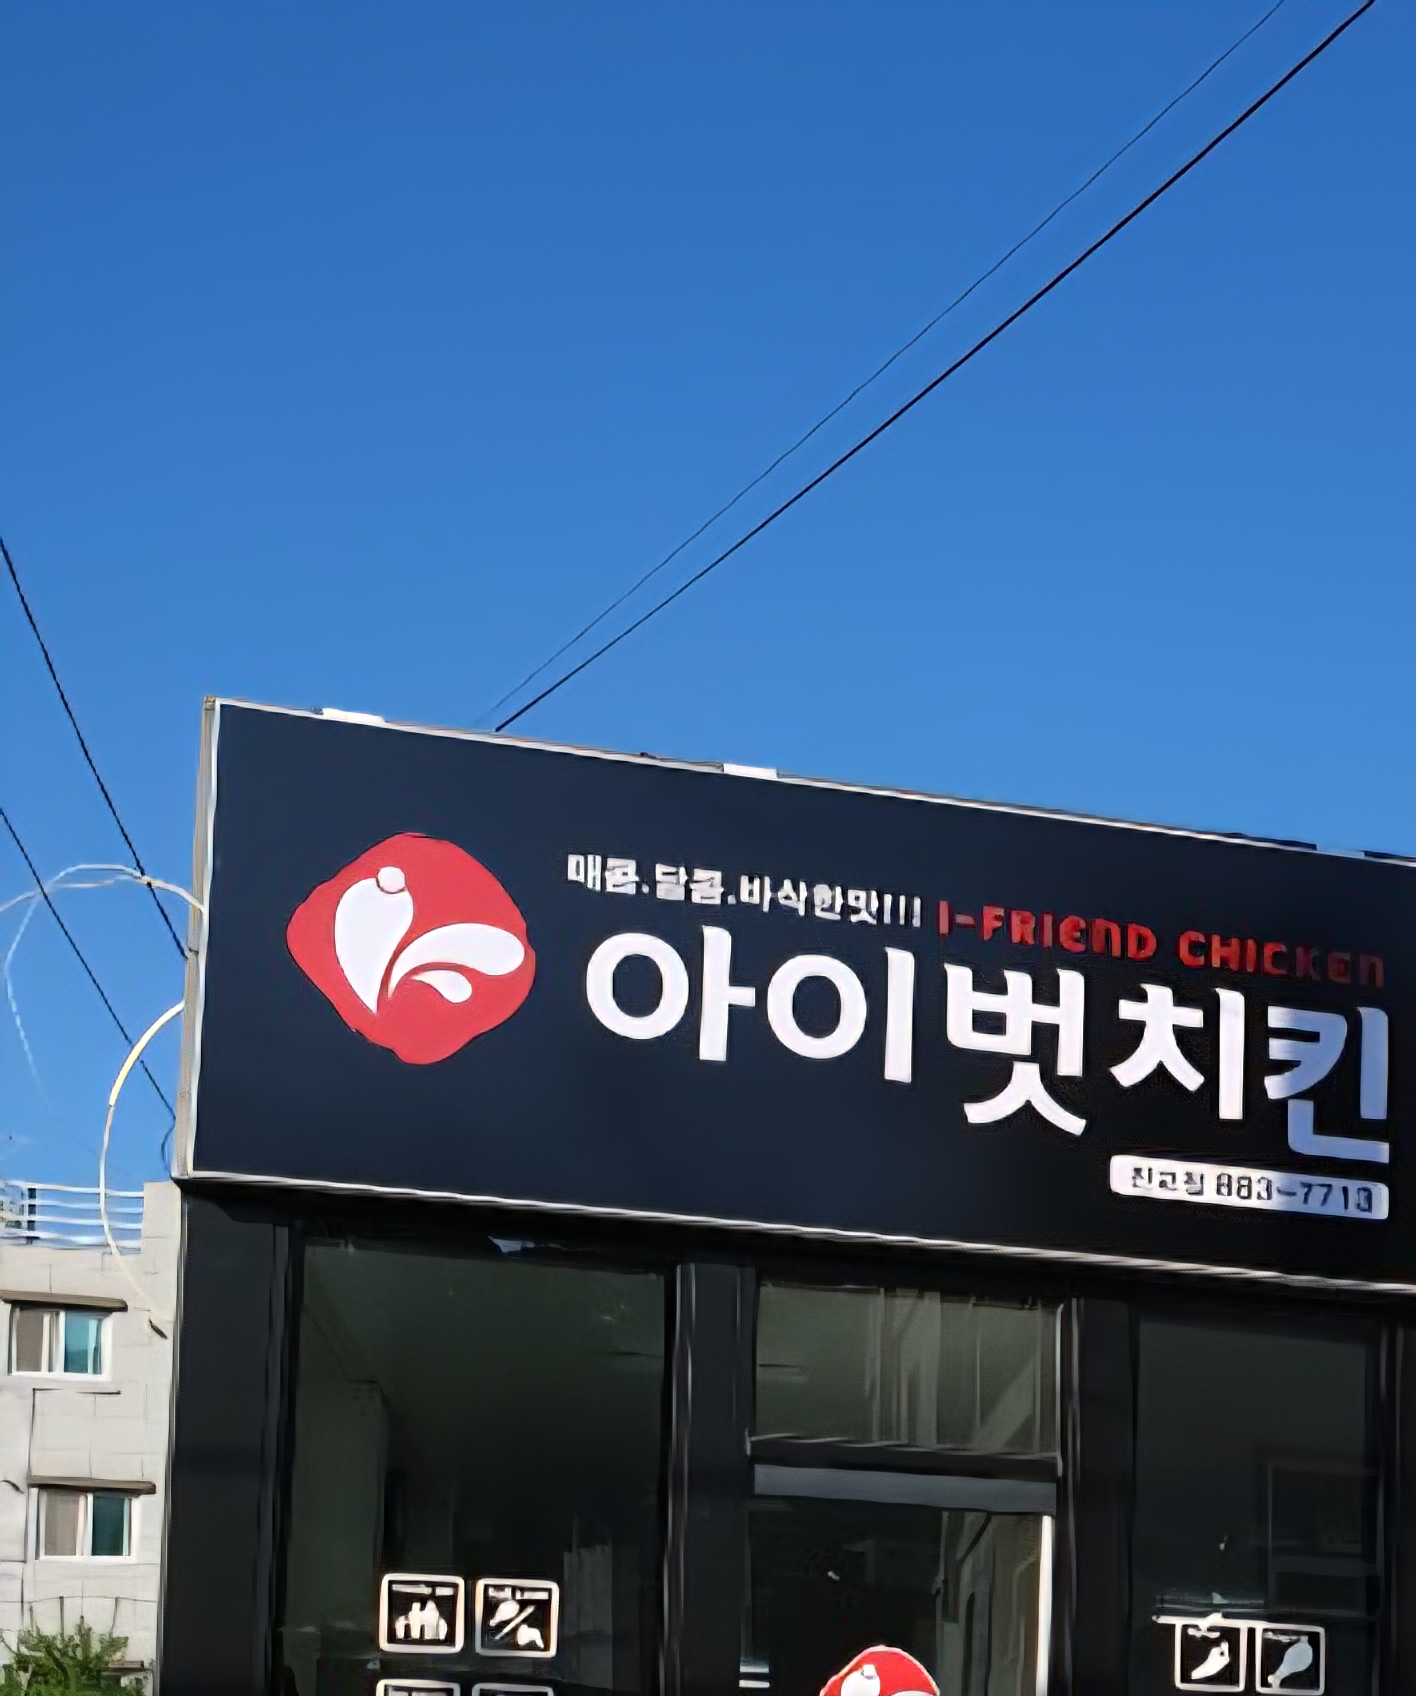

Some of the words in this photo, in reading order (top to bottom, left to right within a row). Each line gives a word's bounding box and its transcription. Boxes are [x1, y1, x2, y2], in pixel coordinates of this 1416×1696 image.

[1178, 930, 1386, 989] CHICKEN
[585, 924, 1393, 1165] 아이벗치킨
[1216, 1172, 1373, 1214] 883-7713
